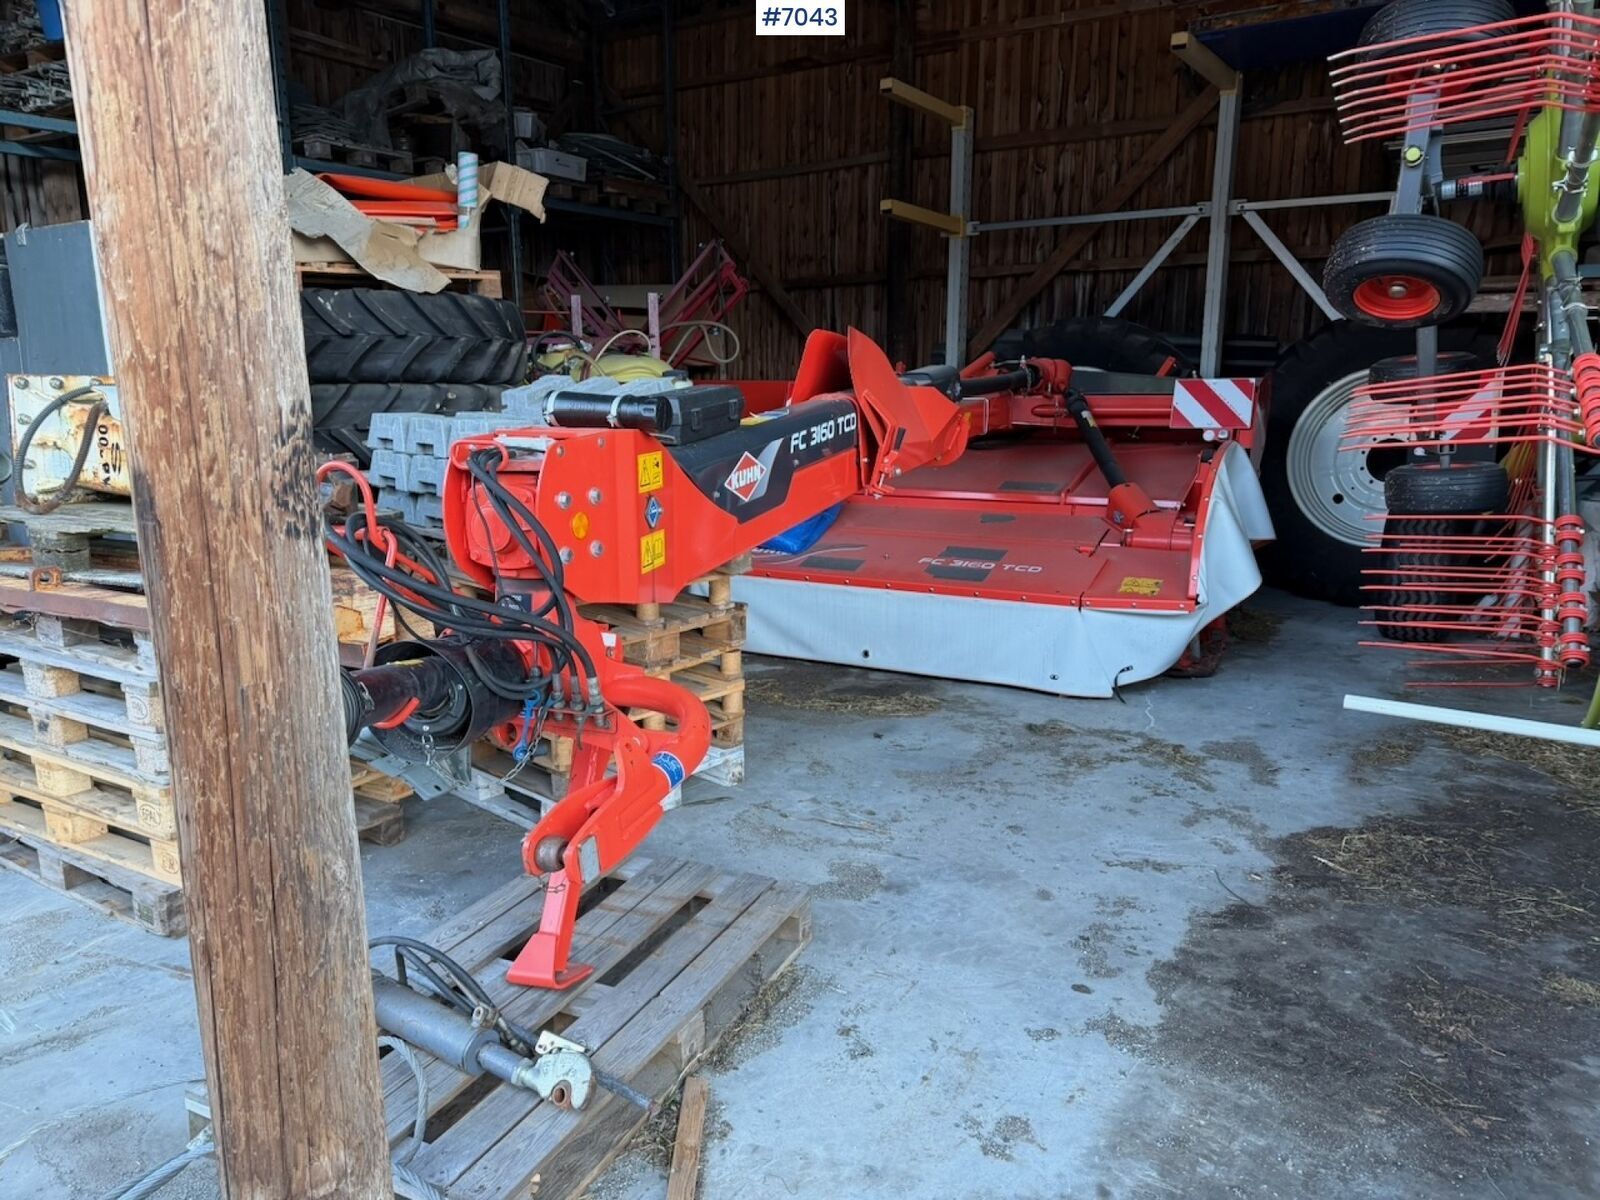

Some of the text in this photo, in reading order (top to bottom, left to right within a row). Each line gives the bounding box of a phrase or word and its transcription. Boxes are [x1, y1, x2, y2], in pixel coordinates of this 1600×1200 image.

[790, 412, 857, 454] FC 3160 TCD
[730, 463, 761, 490] KUHN
[918, 557, 1042, 573] FC 3160 TCD
